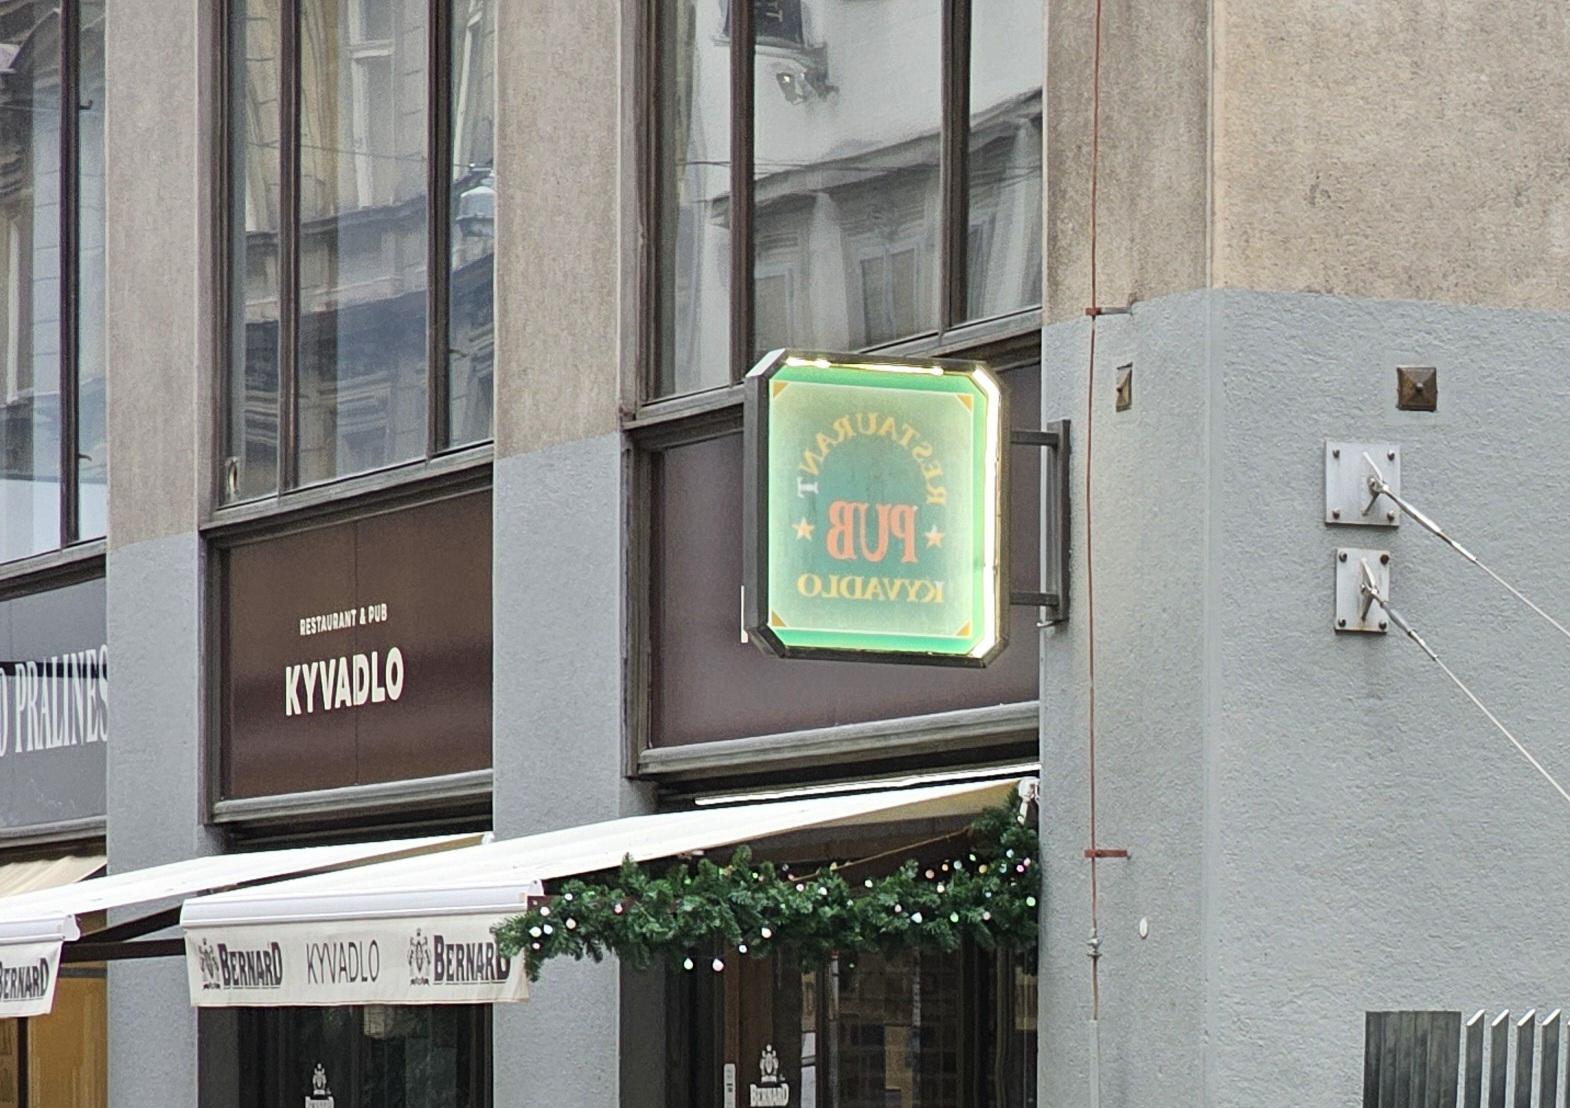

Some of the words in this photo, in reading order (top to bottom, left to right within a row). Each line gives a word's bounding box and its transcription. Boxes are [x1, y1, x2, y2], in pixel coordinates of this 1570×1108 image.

[300, 608, 356, 636] RESTAURANT
[368, 603, 388, 623] PUB
[14, 643, 108, 754] PRALINES
[285, 646, 404, 716] KYVADLO
[216, 941, 283, 988] BERNARD
[306, 938, 381, 985] KYVADLO
[433, 934, 510, 983] BERNARD
